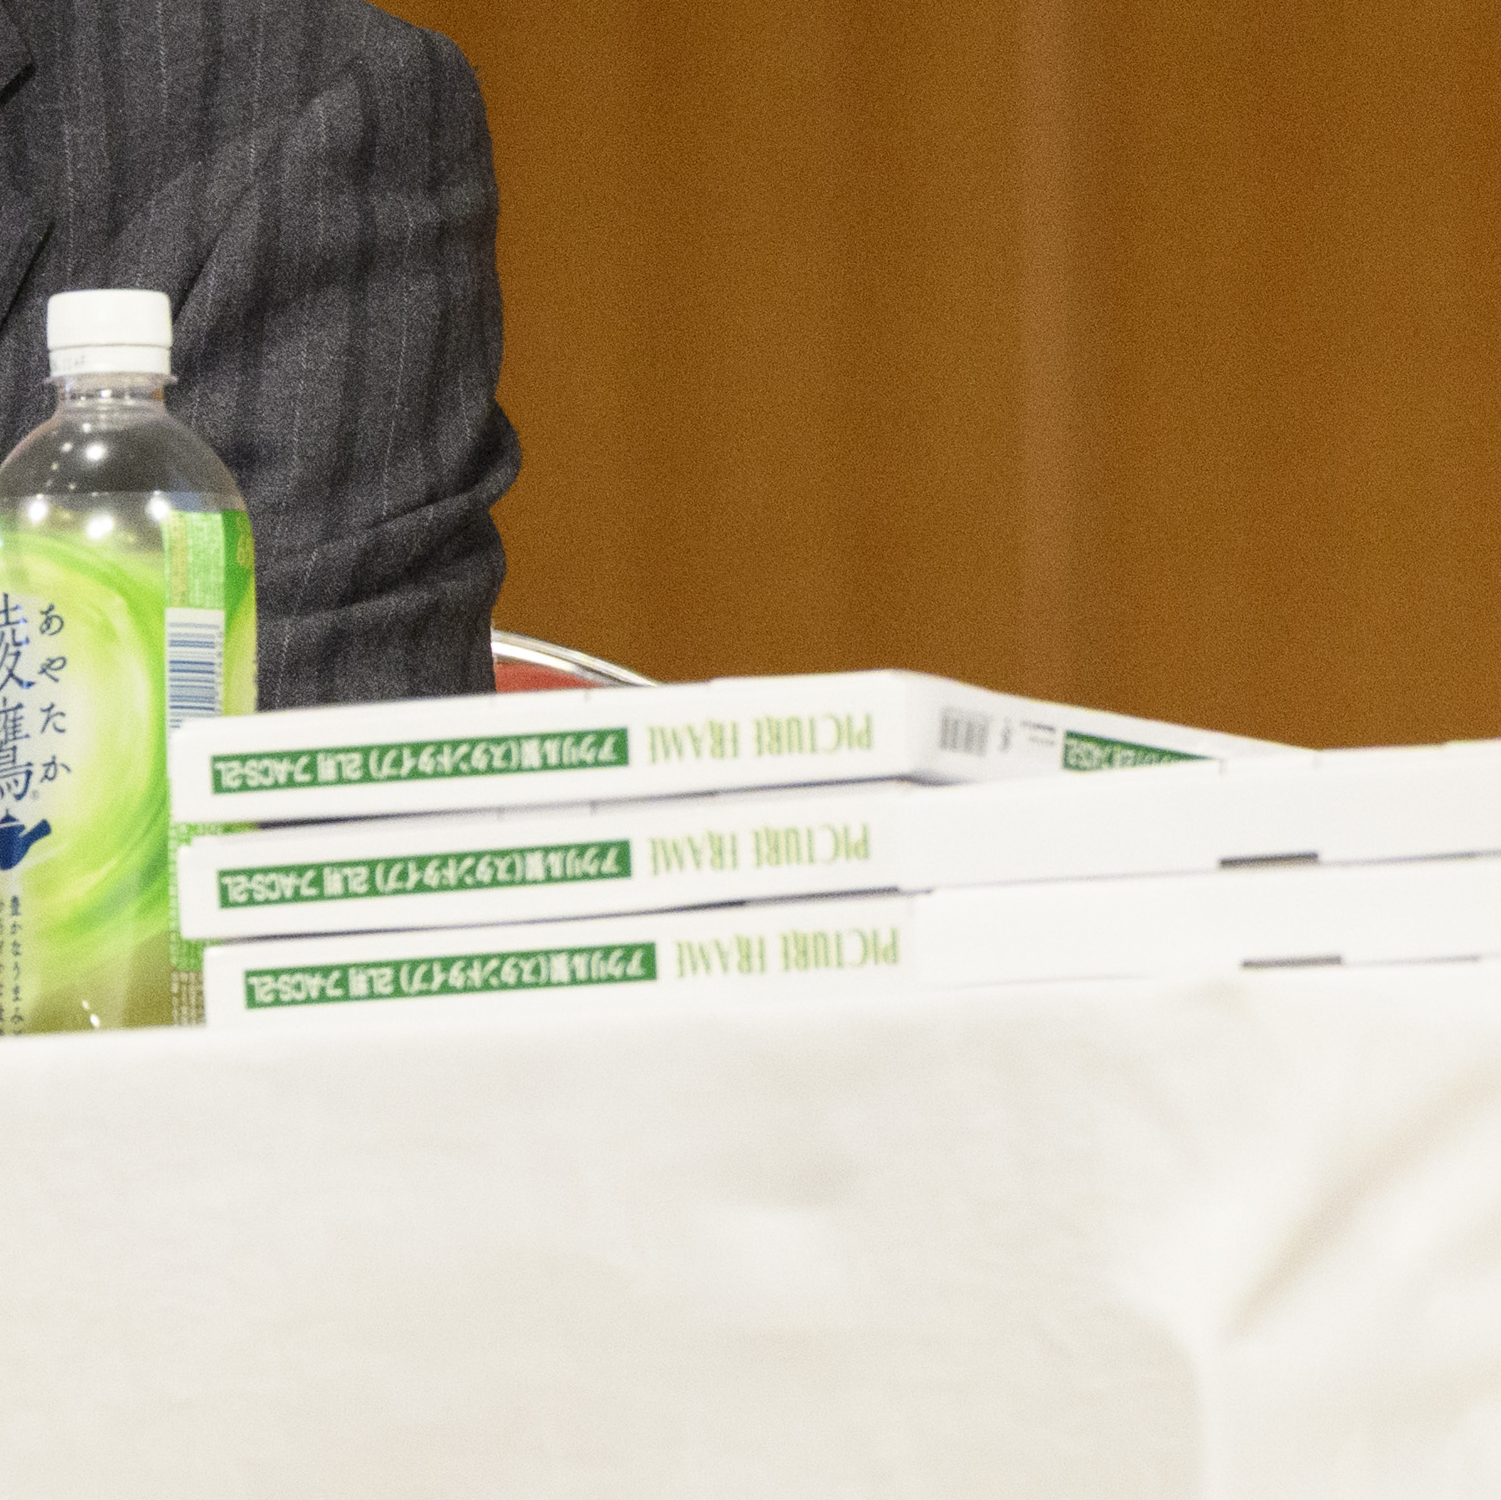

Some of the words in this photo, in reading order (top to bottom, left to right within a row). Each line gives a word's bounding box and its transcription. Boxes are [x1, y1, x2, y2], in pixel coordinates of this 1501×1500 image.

[38, 604, 72, 784] あやたか
[754, 713, 873, 758] PICTURE
[752, 822, 871, 869] PICTURE
[780, 927, 899, 974] PICTURE
